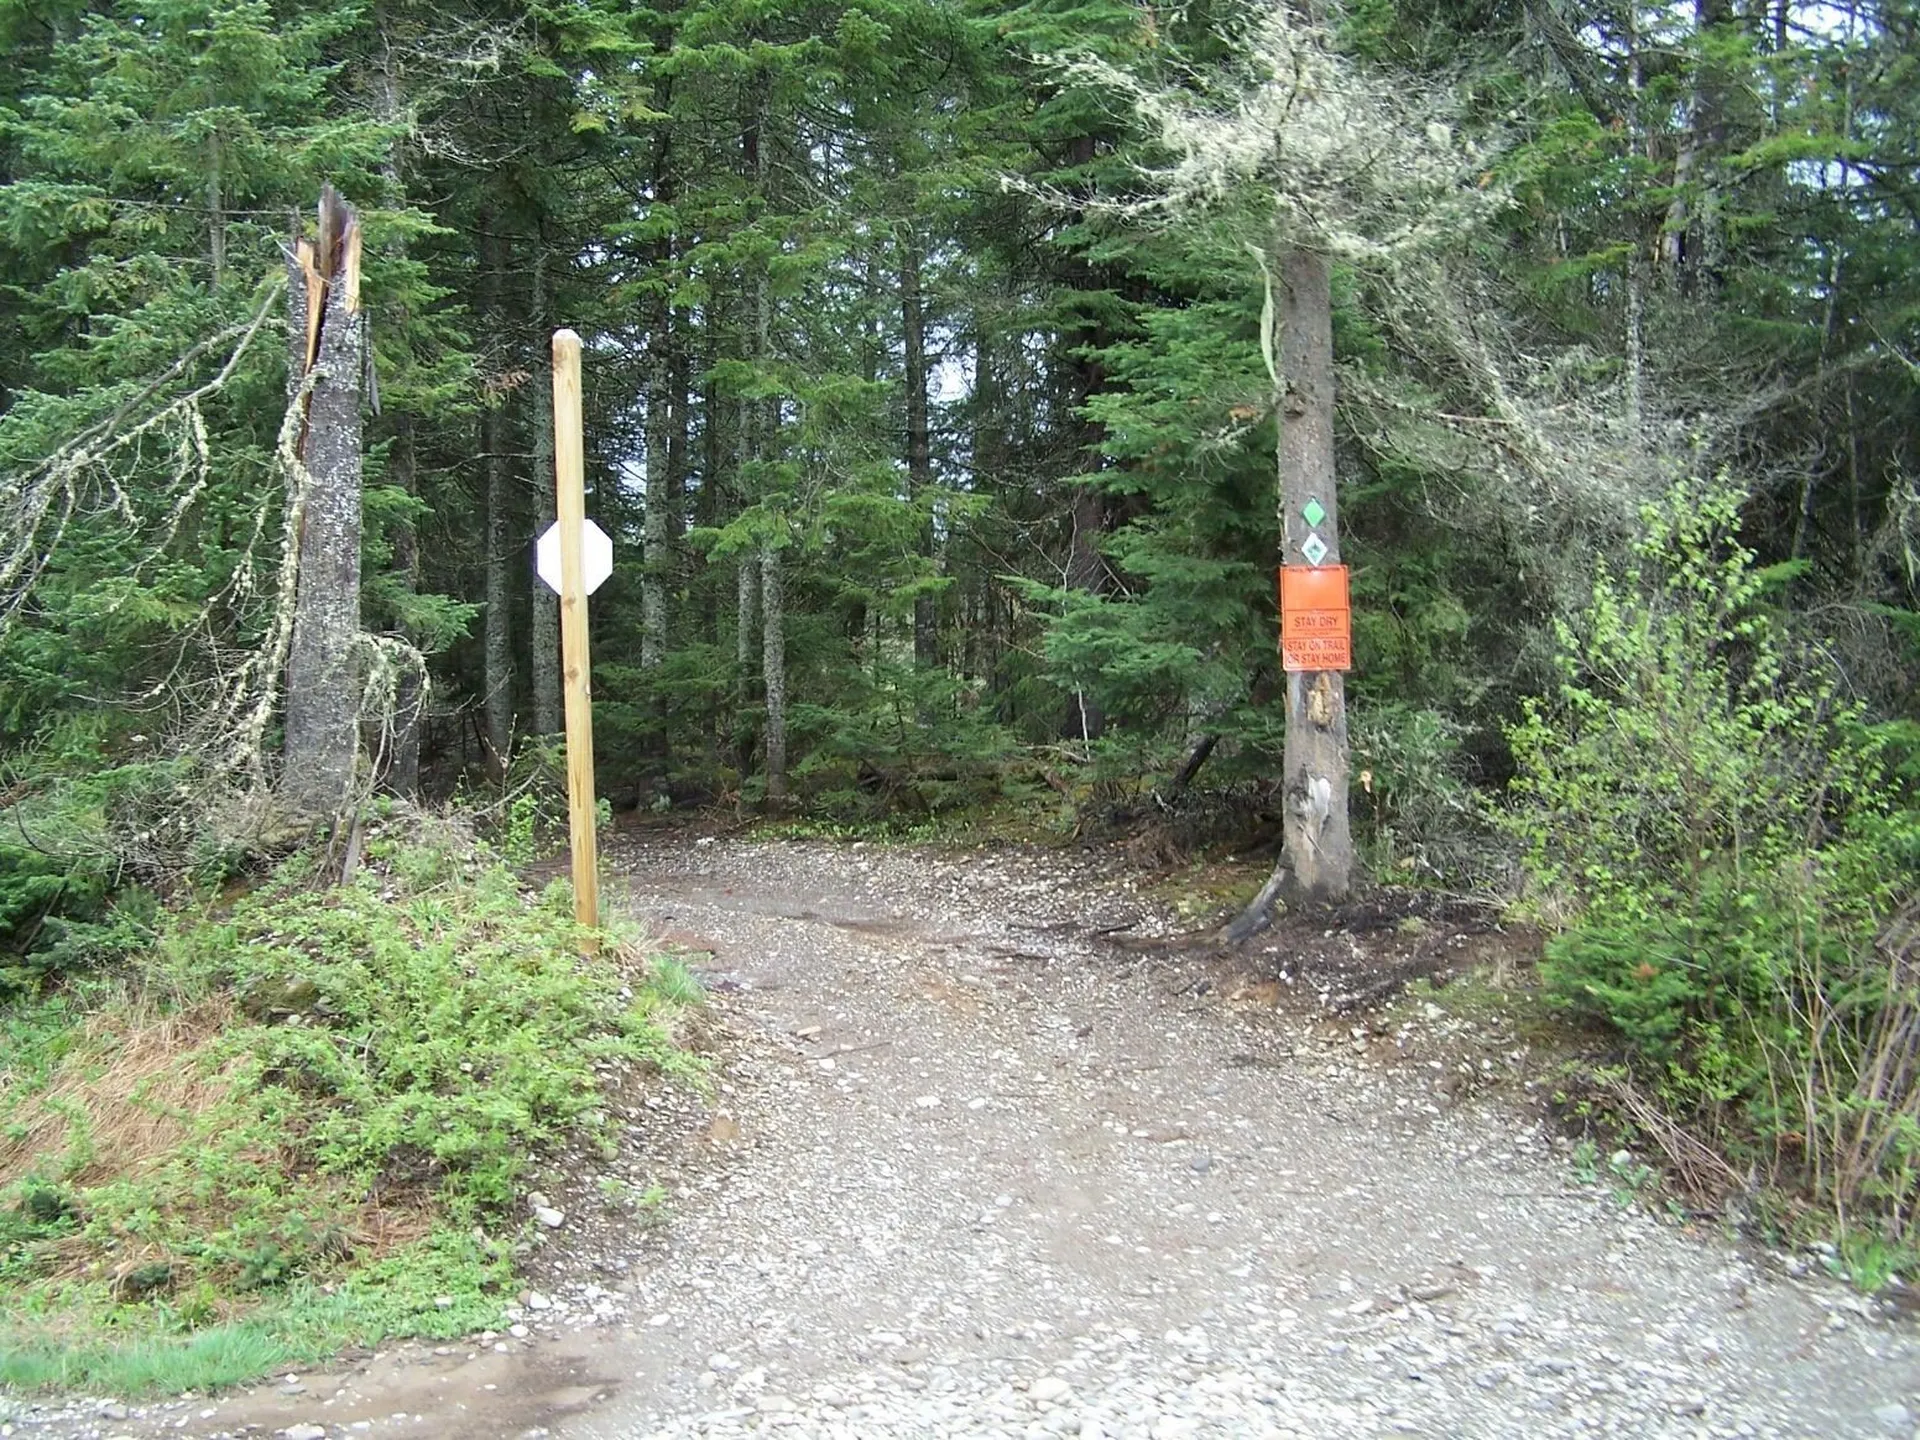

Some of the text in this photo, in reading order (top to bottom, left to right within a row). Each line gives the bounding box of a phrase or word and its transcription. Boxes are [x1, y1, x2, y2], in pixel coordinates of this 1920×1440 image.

[1294, 616, 1337, 627] STAY DRY
[1287, 640, 1345, 651] STAY ON TRAIL
[1301, 653, 1319, 664] STAY
[1322, 653, 1346, 663] HOME
